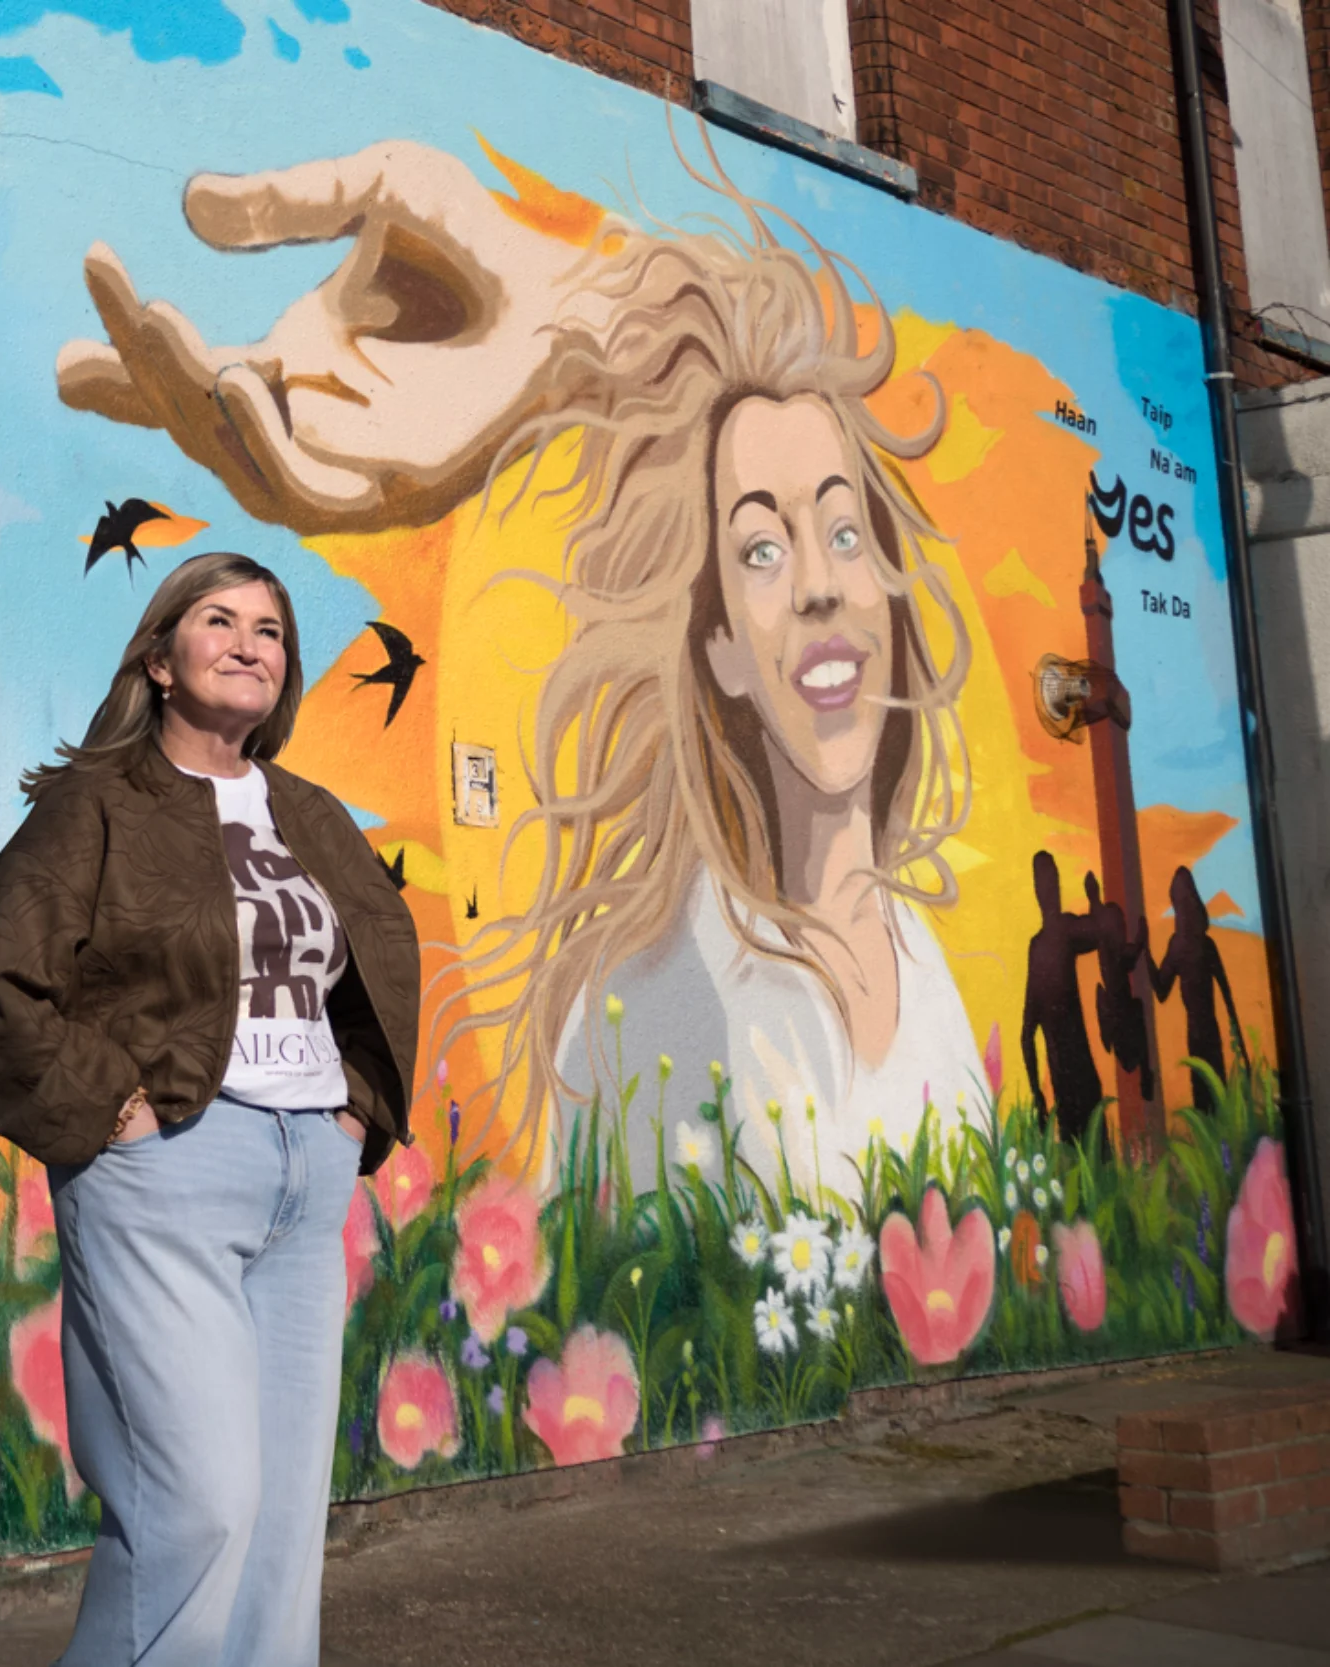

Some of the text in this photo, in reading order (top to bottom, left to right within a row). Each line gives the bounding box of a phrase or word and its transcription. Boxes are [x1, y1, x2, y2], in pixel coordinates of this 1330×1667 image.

[1054, 399, 1098, 436] Haan
[1141, 396, 1173, 432] Taip
[1141, 589, 1192, 620] Tak Da
